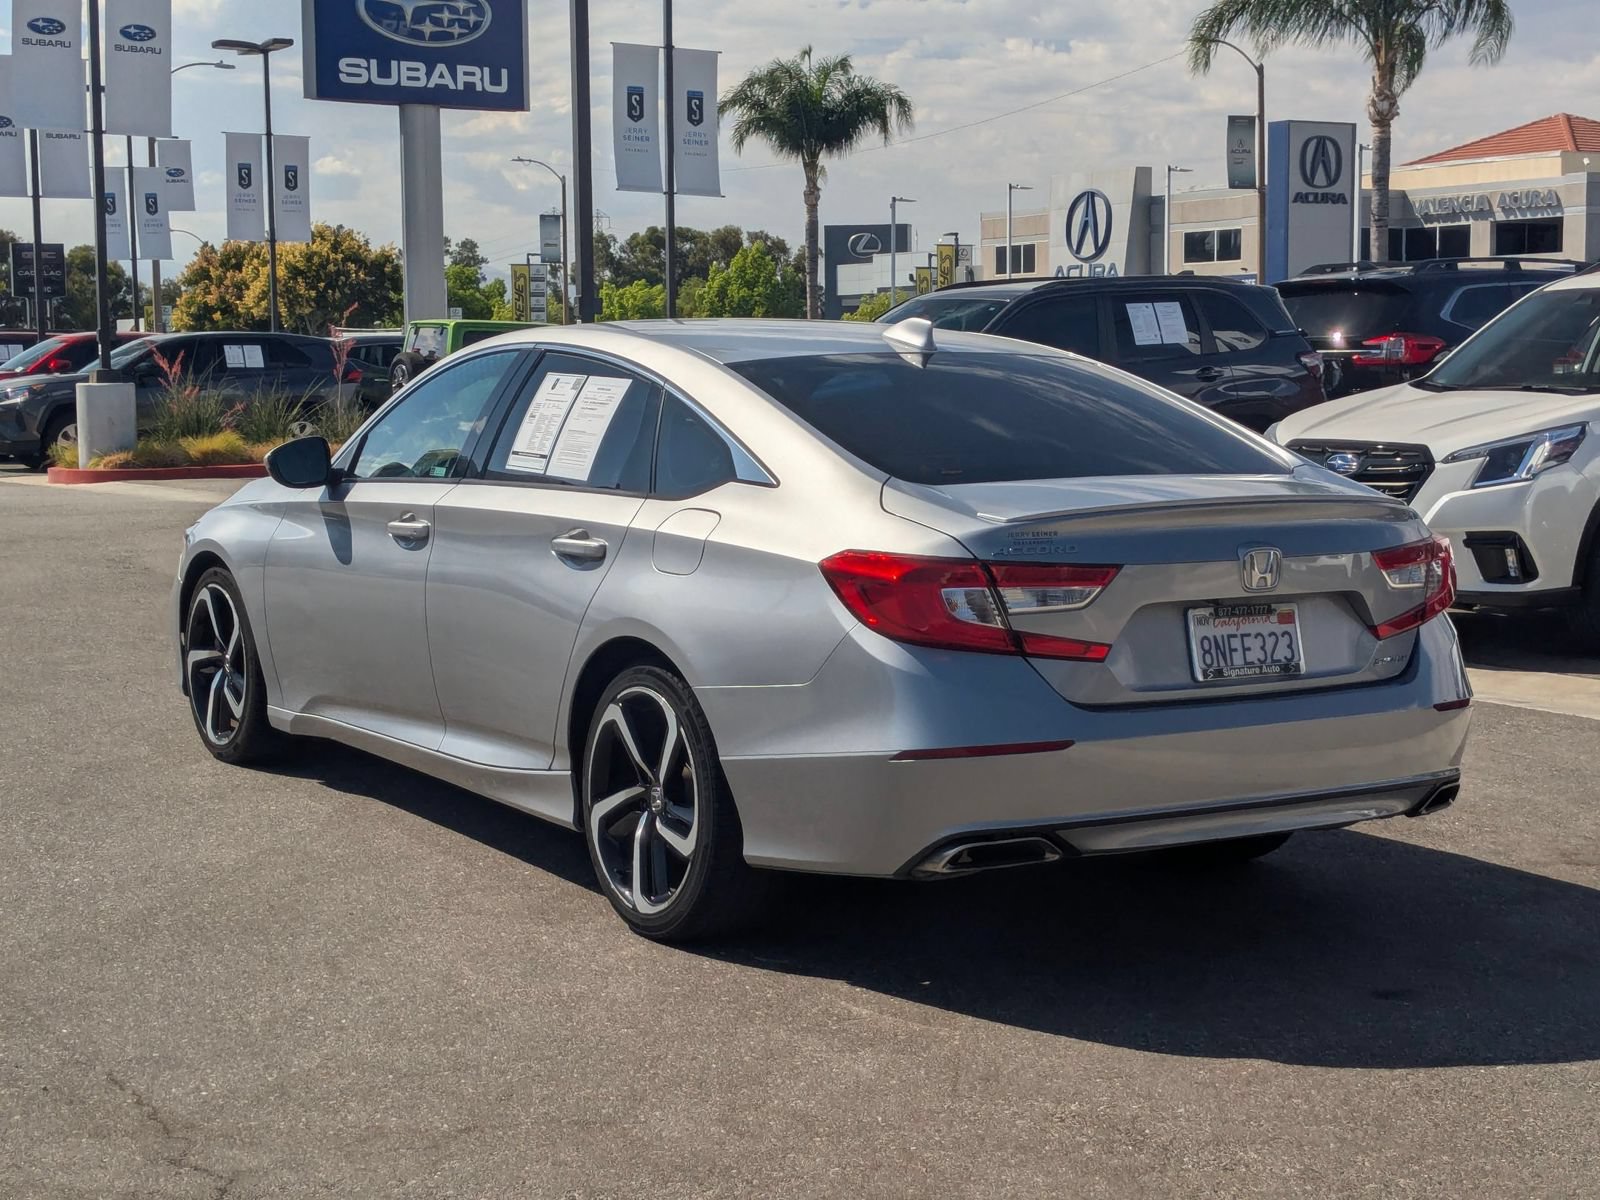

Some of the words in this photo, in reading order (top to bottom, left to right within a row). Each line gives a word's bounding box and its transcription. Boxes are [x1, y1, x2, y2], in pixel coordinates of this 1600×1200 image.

[21, 37, 72, 49] SUBARU
[113, 43, 162, 55] SUBARU
[338, 57, 508, 93] SUBARU
[45, 132, 81, 140] SUBARU
[622, 134, 650, 143] SEINER
[682, 138, 709, 147] SEINER
[1292, 191, 1348, 205] ACURA
[1412, 194, 1490, 215] VALENCIA
[1497, 189, 1558, 208] ACURA
[1200, 630, 1296, 668] 8NFE323
[1222, 668, 1260, 677] Signature
[1261, 664, 1280, 674] Auto
